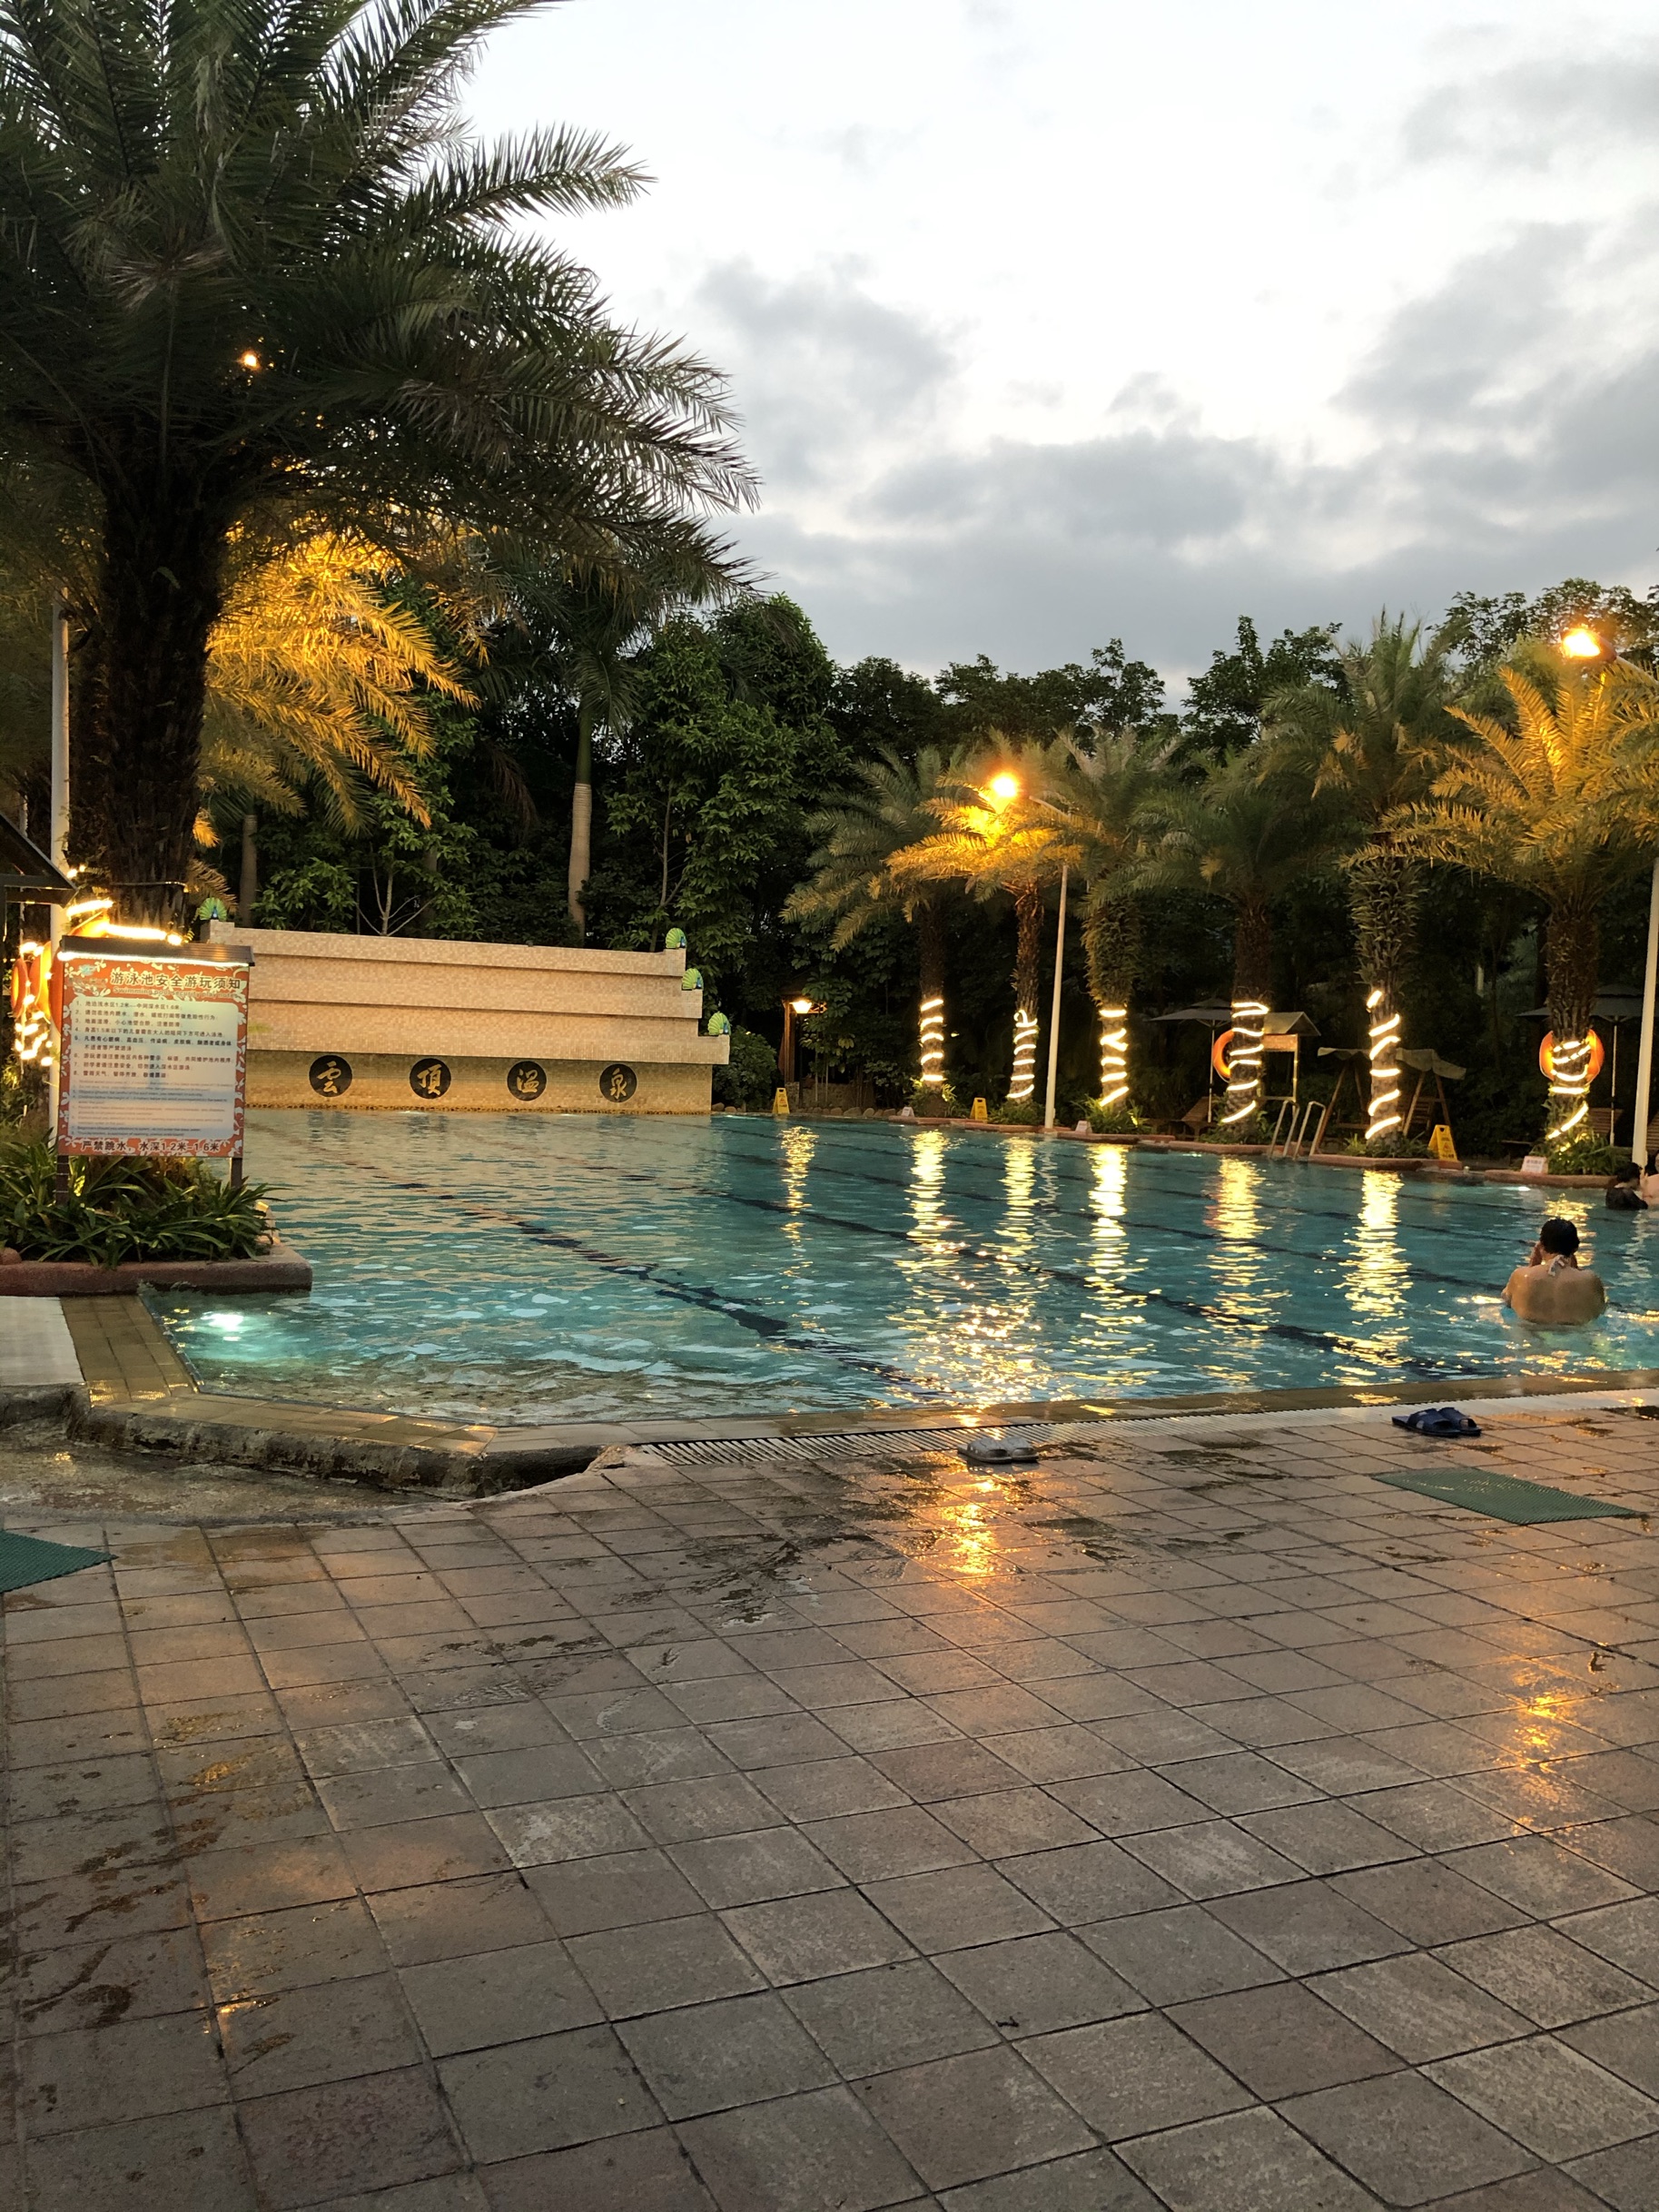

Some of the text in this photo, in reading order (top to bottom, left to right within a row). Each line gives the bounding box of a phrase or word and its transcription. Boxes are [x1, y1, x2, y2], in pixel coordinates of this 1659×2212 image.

[111, 972, 241, 989] 游泳池安全游玩须知
[114, 986, 153, 995] Swimming
